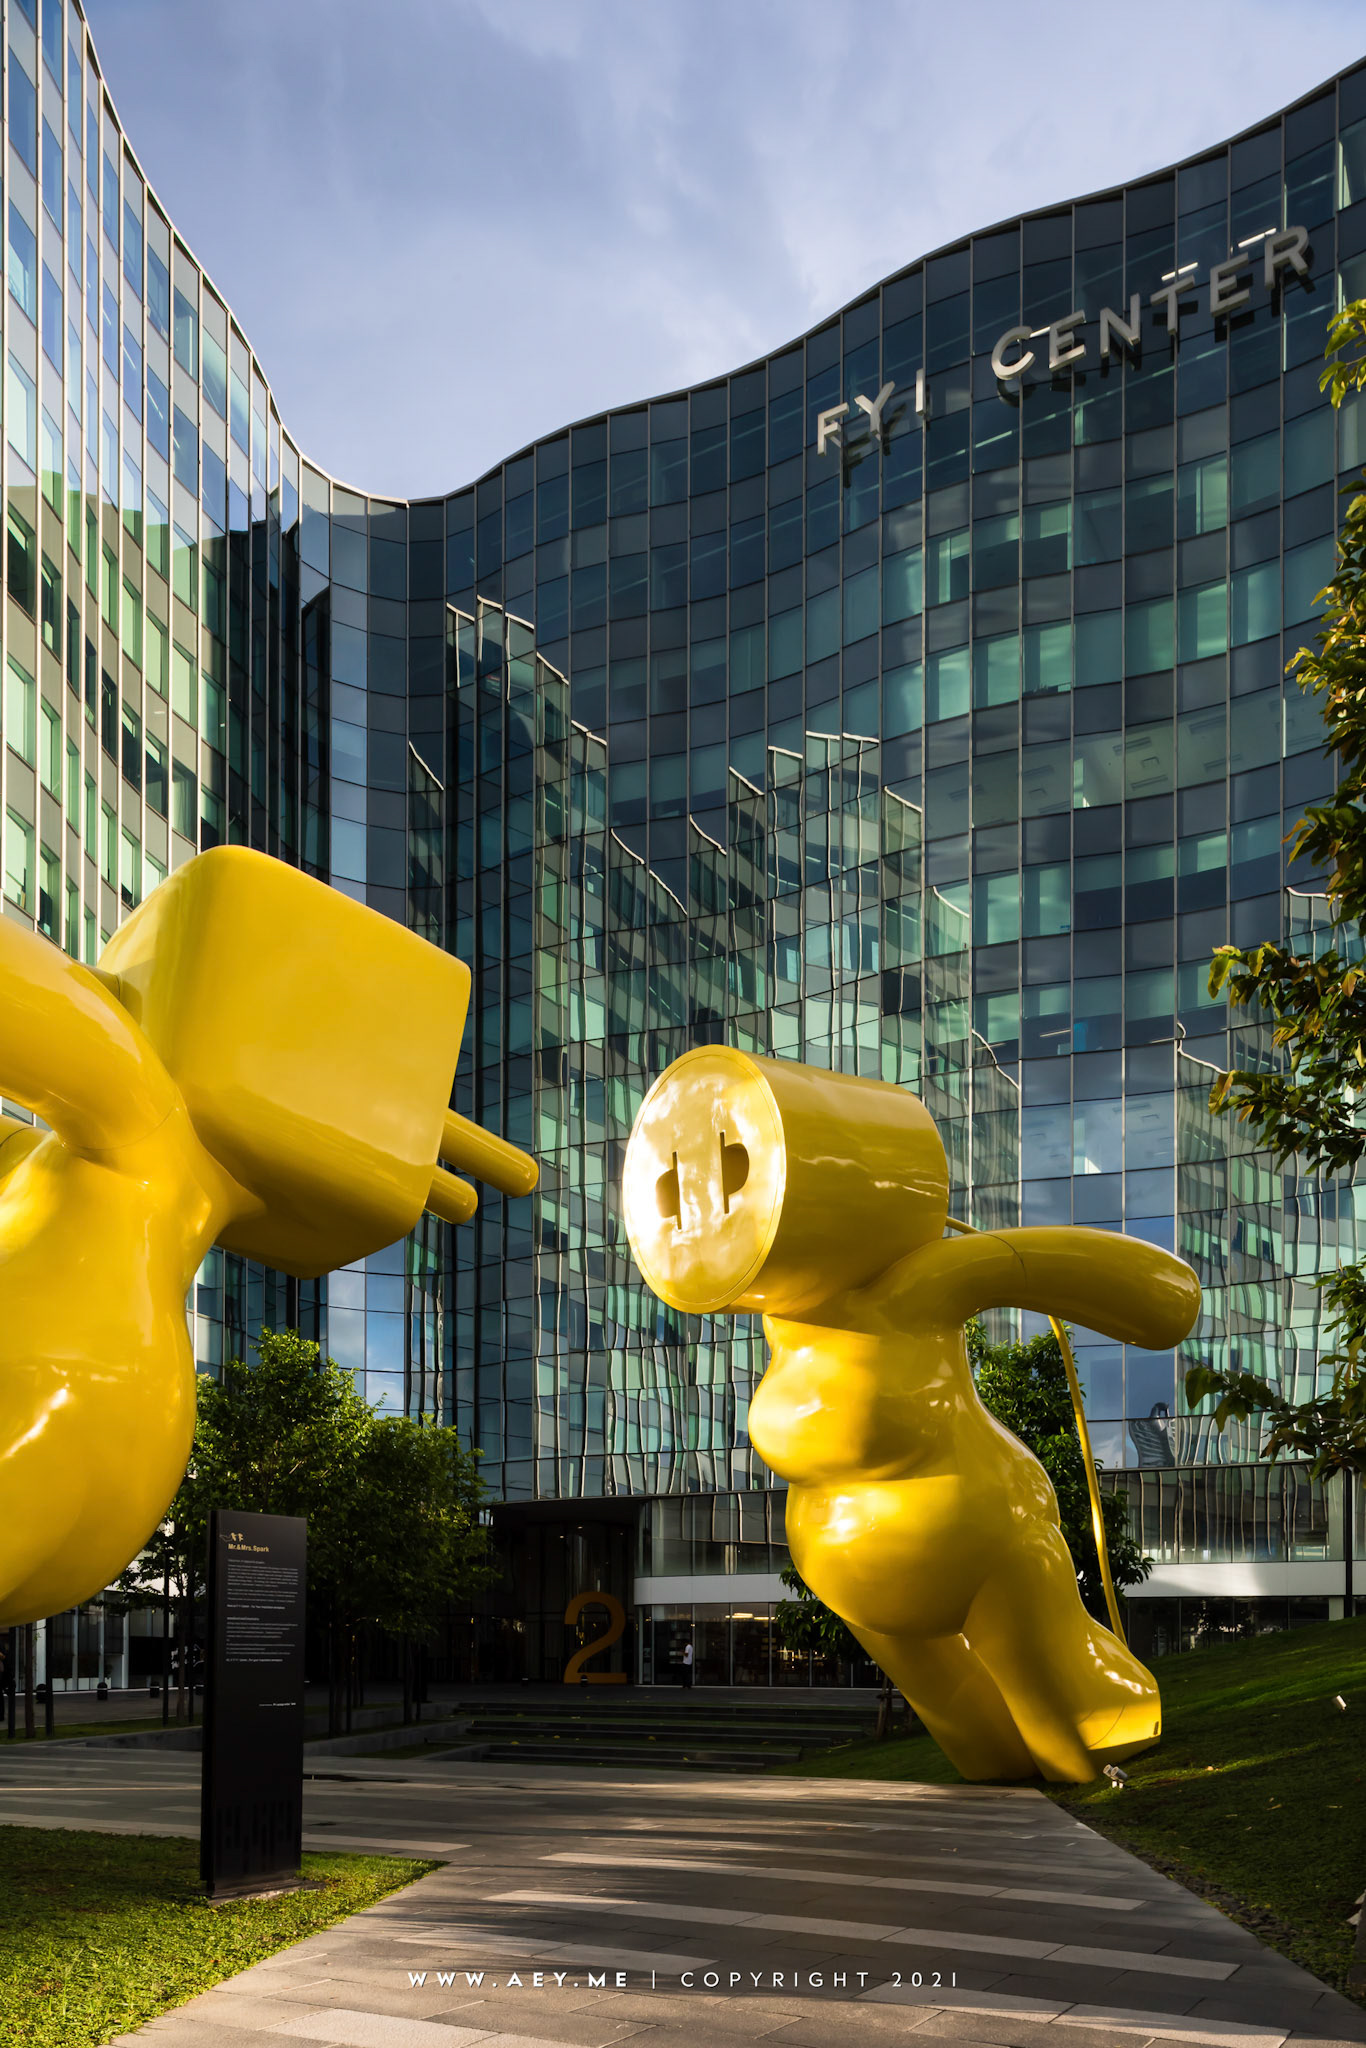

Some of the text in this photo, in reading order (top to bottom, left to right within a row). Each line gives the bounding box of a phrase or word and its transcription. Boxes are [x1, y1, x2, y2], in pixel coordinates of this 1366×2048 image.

[816, 225, 1310, 457] FYI CENTER
[563, 1591, 628, 1684] 2
